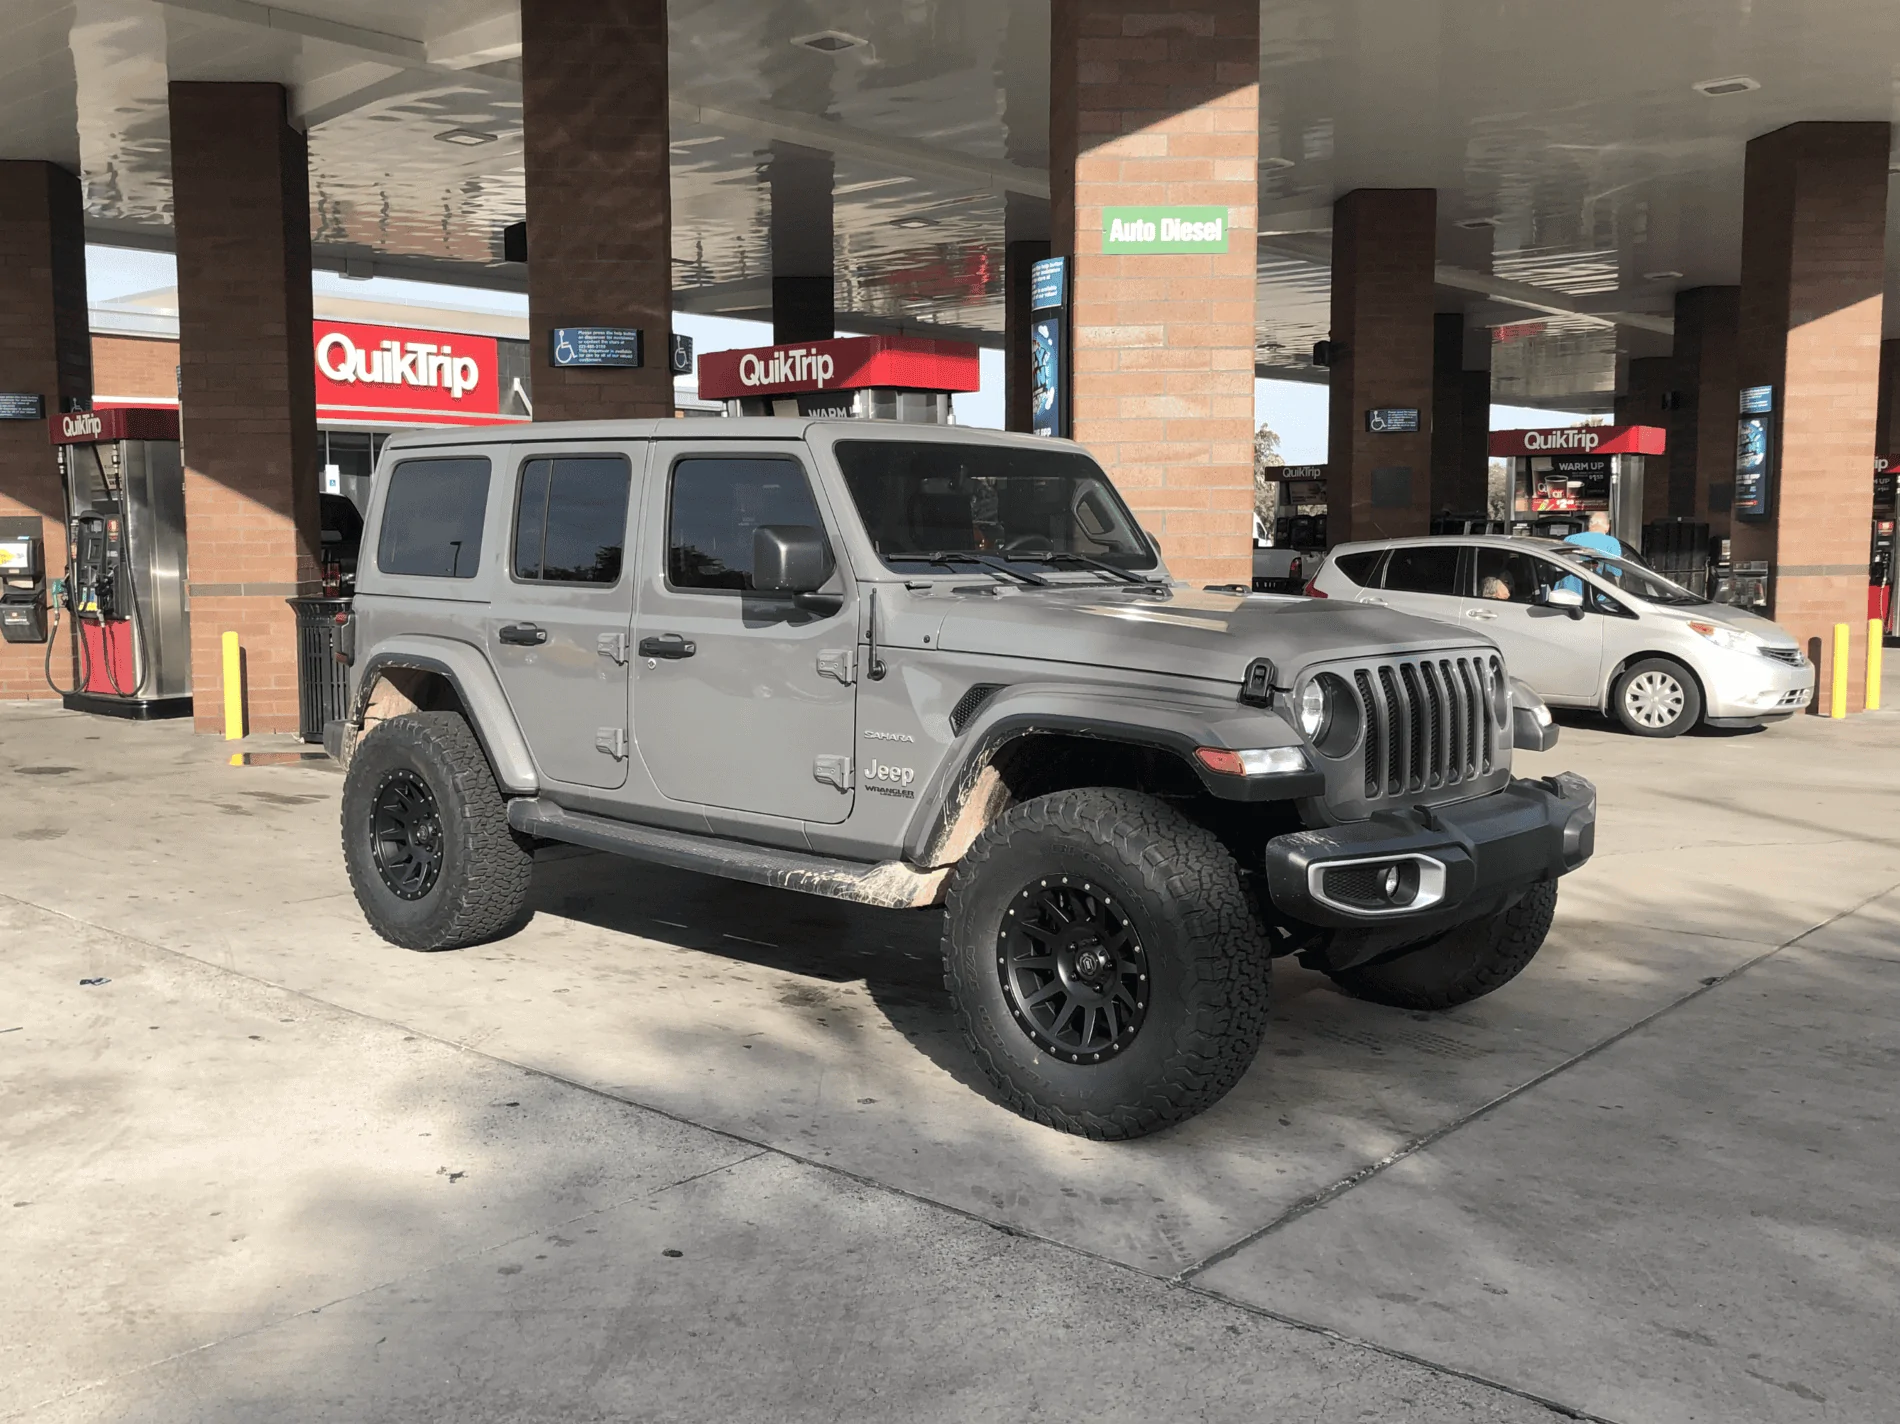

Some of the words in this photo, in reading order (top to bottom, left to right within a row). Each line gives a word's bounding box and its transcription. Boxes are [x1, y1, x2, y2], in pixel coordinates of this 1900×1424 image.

[1109, 217, 1156, 242] Auto
[1160, 217, 1222, 242] Diesel
[316, 333, 479, 399] QuikTrip
[739, 348, 834, 389] QuikTrip
[63, 413, 102, 439] QuikTrip
[1524, 429, 1599, 452] QuikTrip
[1282, 466, 1321, 480] QuikTrip
[1558, 462, 1589, 471] WARM
[1590, 461, 1605, 470] UP
[864, 730, 915, 743] SAHARA
[863, 758, 915, 787] Jeep
[864, 784, 915, 797] WRANGLER
